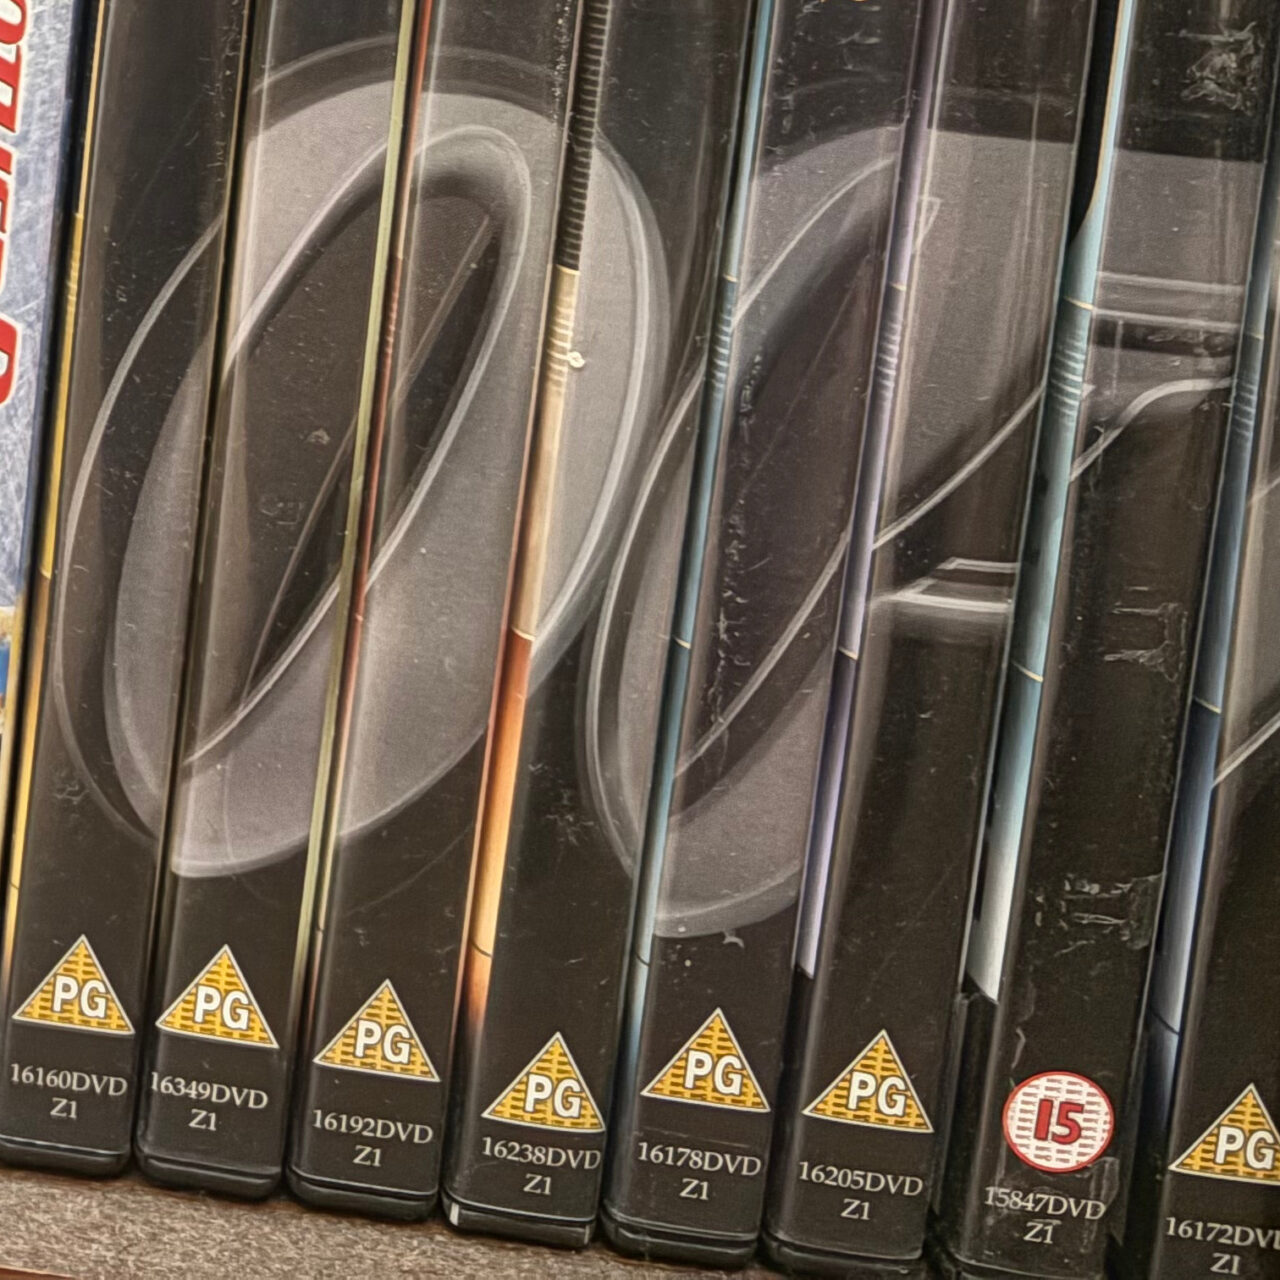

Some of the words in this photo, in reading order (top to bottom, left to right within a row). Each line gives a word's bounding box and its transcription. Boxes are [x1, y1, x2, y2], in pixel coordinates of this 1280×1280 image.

[51, 973, 108, 1019] PG
[193, 985, 250, 1030] PG
[353, 1019, 412, 1065] PG
[11, 1063, 128, 1096] 16160DVD
[683, 1049, 743, 1096] PG
[151, 1072, 268, 1109] 16349DVD
[523, 1073, 584, 1119] PG
[847, 1070, 907, 1117] PG
[50, 1097, 78, 1119] Z1
[188, 1108, 218, 1132] Z1
[1033, 1098, 1085, 1145] 15
[312, 1109, 434, 1144] 16192DVD
[352, 1145, 382, 1167] Z1
[481, 1136, 602, 1170] 16238DVD
[638, 1142, 762, 1176] 16178DVD
[1213, 1124, 1276, 1171] PG
[523, 1173, 552, 1195] Z1
[679, 1178, 710, 1200] Z1
[799, 1161, 924, 1197] 16205DVD
[840, 1198, 871, 1221] Z1
[984, 1186, 1106, 1220] 15847DVD
[1023, 1222, 1054, 1245] Z1
